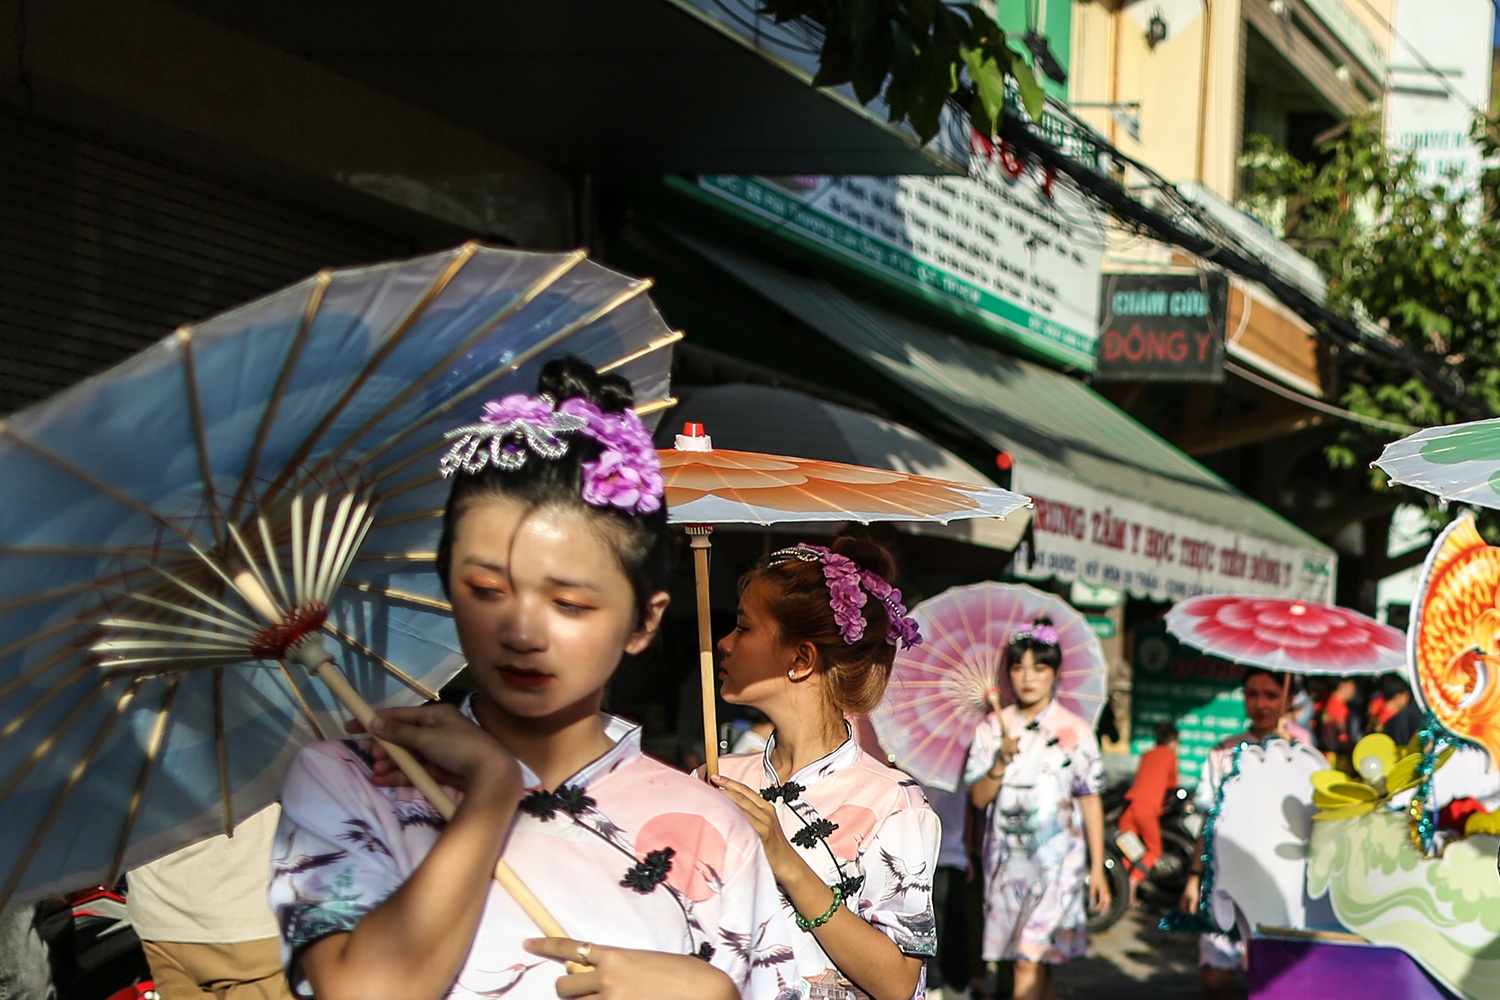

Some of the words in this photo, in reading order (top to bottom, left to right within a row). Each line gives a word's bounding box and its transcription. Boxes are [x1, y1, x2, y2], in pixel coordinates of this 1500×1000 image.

[1103, 323, 1189, 362] ĐÔNG
[1194, 330, 1213, 362] Y
[1091, 506, 1127, 550] TÂM
[1130, 522, 1143, 554] Y
[1144, 526, 1176, 567] HỌC
